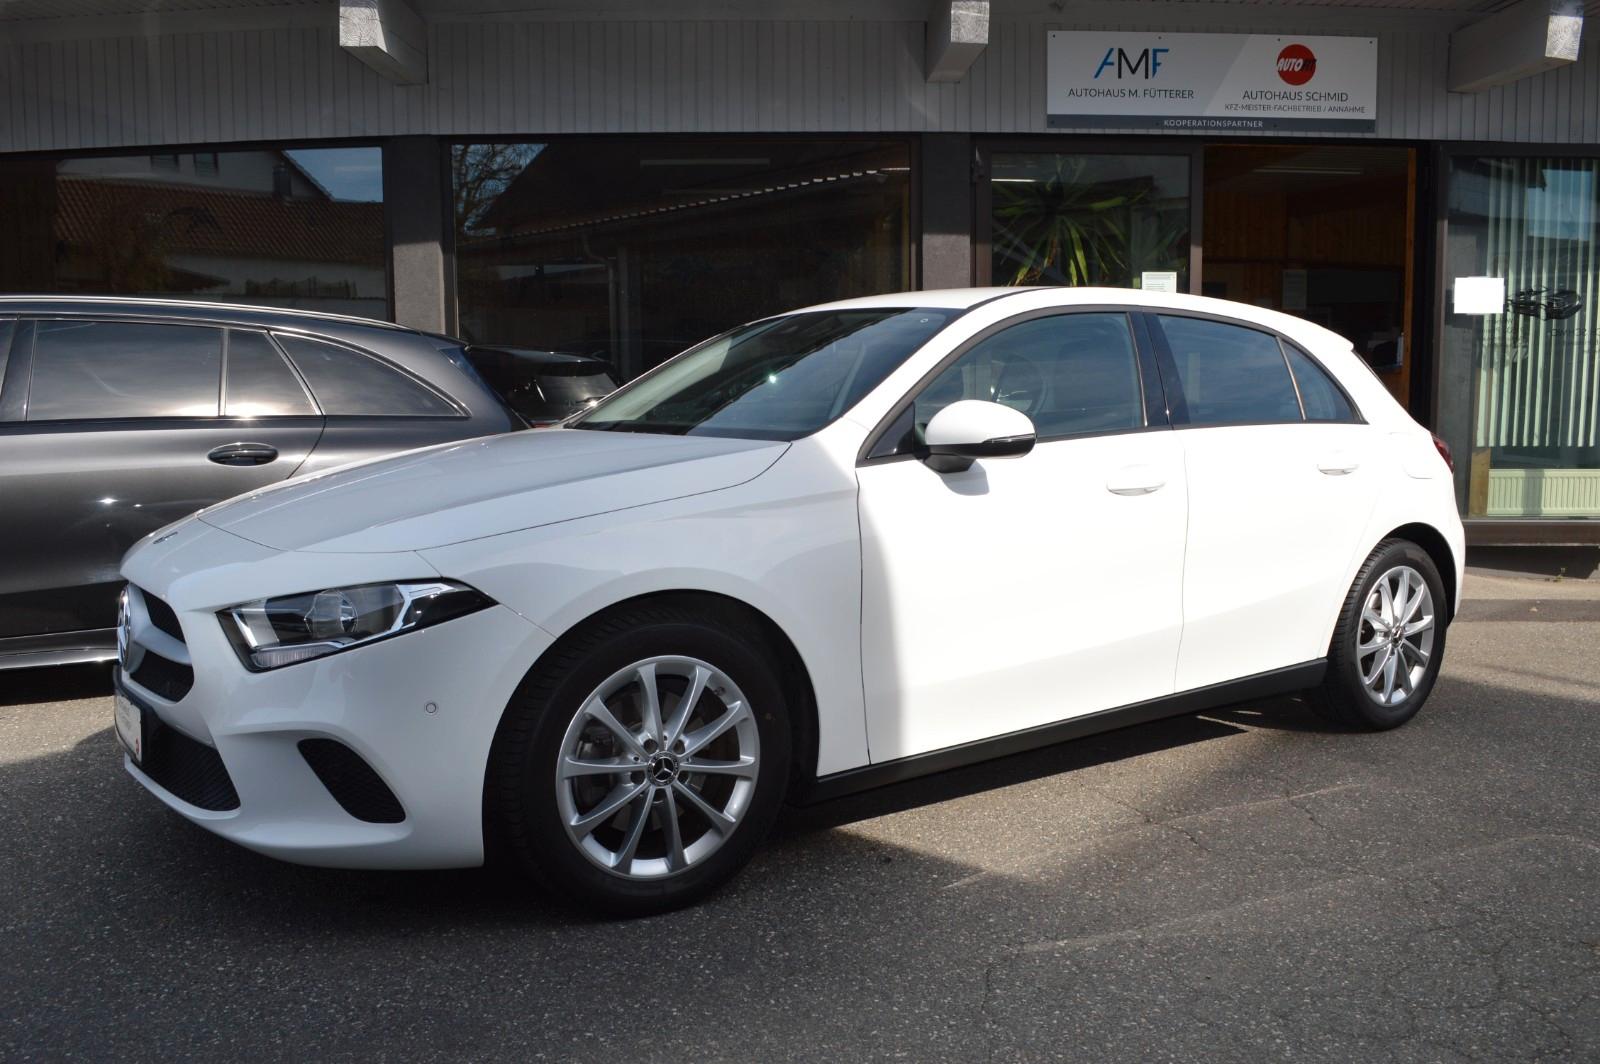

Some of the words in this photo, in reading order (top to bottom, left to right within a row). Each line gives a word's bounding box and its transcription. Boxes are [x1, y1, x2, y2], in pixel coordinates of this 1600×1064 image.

[1094, 48, 1169, 79] AMF
[1068, 88, 1126, 97] AUTOHAUS
[1128, 89, 1140, 98] M.
[1143, 88, 1194, 99] FÜTTERER
[1243, 91, 1303, 101] AUTOHAUS
[1305, 91, 1349, 102] SCHMID
[1328, 105, 1366, 114] ANNAHME
[1163, 119, 1263, 129] KOOPERATIONSPARTNER
